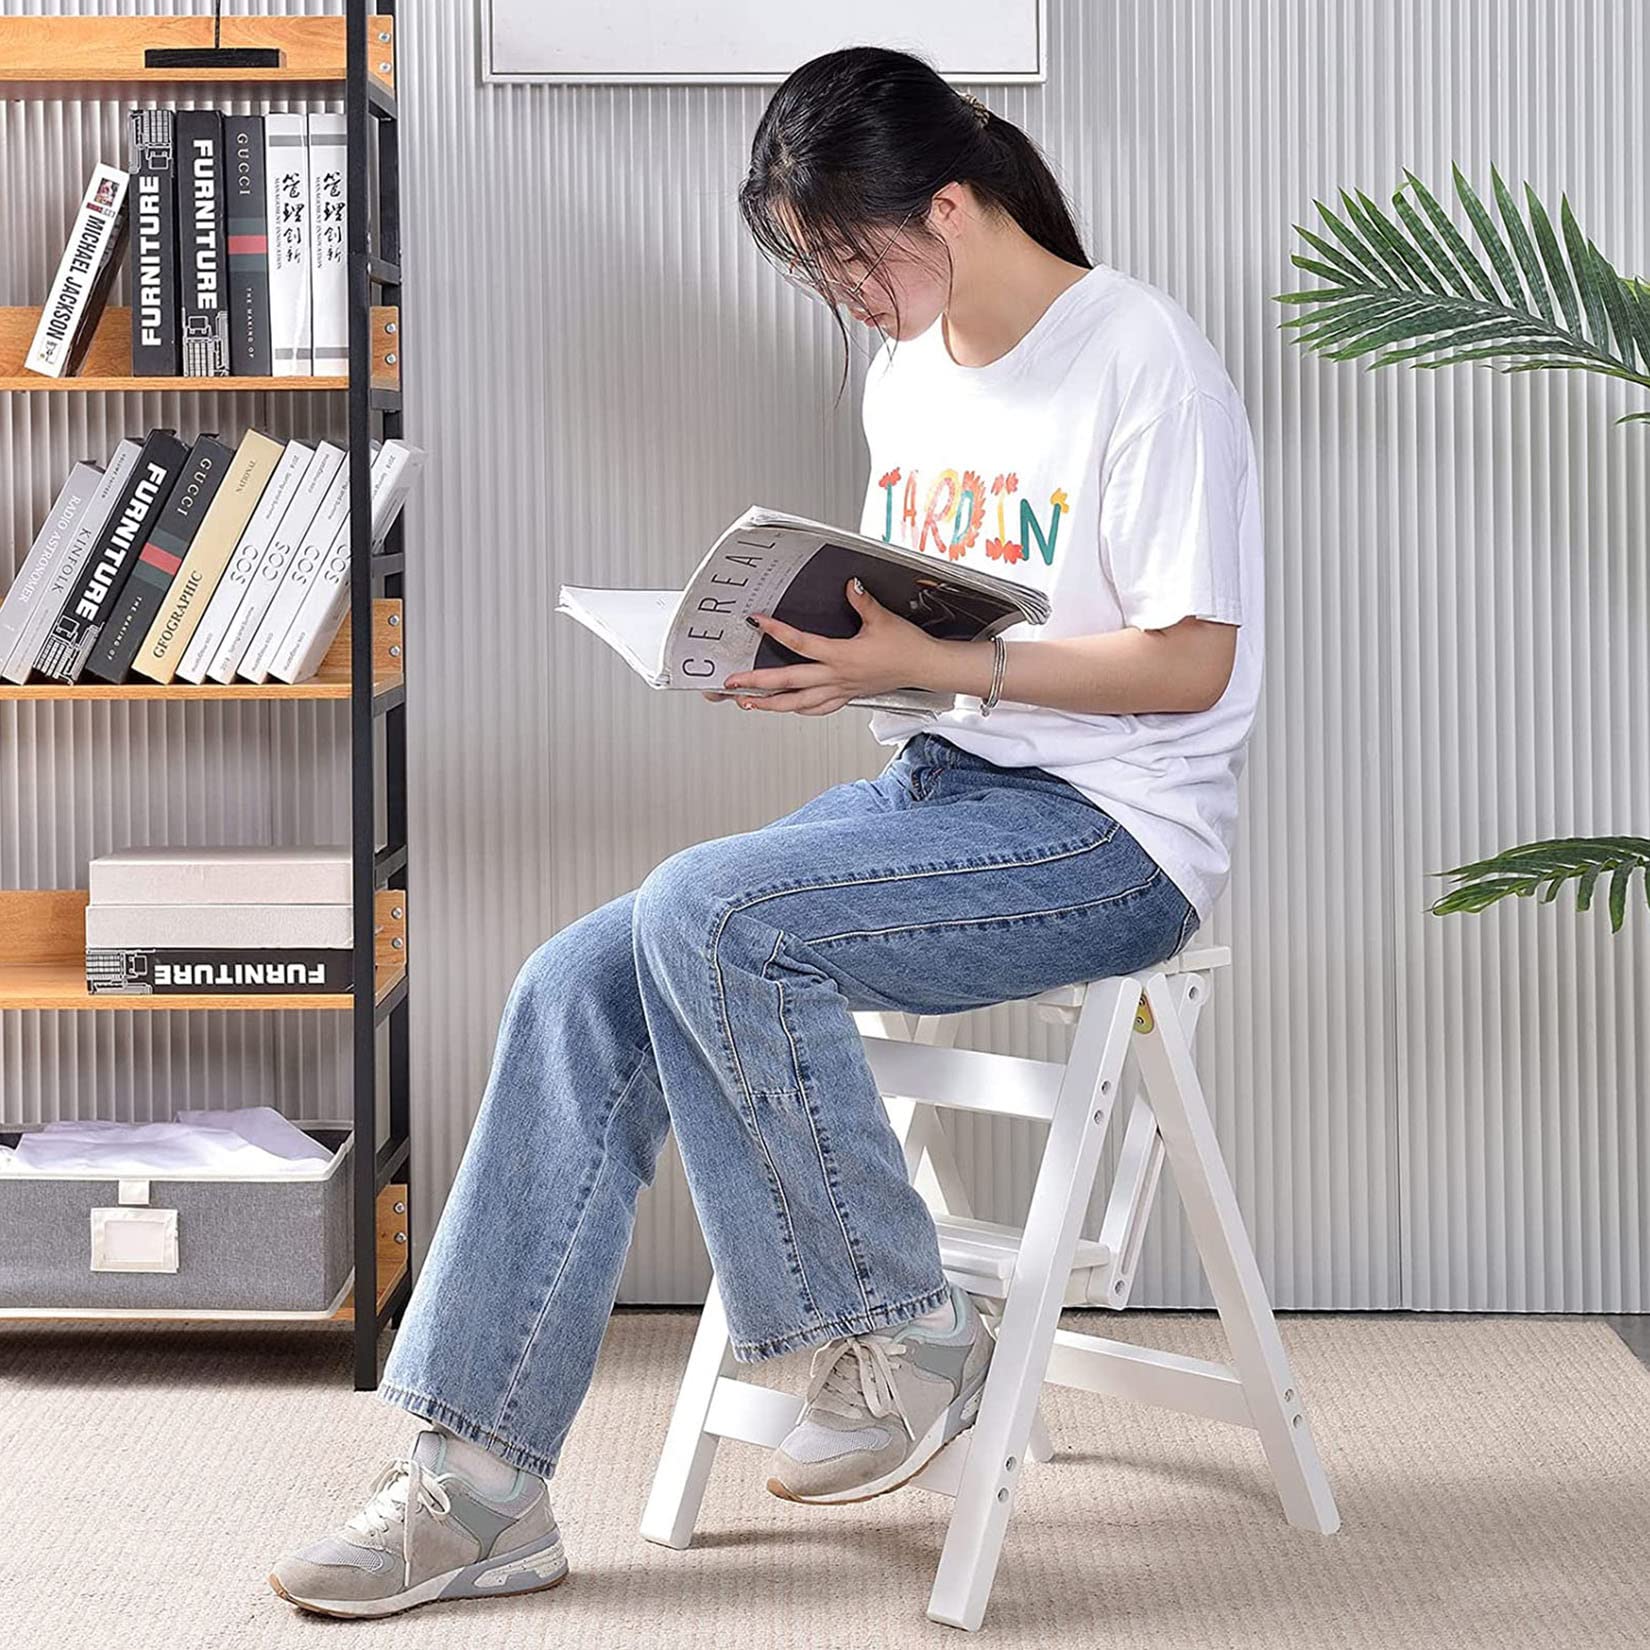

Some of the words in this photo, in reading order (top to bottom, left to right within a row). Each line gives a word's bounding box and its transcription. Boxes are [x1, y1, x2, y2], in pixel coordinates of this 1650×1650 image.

[237, 133, 250, 194] GUCCI
[70, 216, 106, 274] MICHAEL
[193, 139, 218, 310] FURNITURE
[140, 177, 161, 345] FURNITURE
[47, 277, 82, 341] JACKSON
[58, 496, 81, 530] RADIO
[178, 458, 212, 516] GUCCI
[879, 467, 1069, 565] JARDIN
[19, 531, 61, 603] ASTRONOMER
[52, 528, 92, 594] KINFOLK
[76, 464, 167, 621] FURNITURE
[230, 546, 259, 585] COS
[262, 542, 291, 581] COS
[292, 546, 320, 585] COS
[325, 545, 351, 584] COS
[114, 616, 132, 646] MAKING
[132, 597, 142, 612] THE
[682, 541, 776, 677] CEREAL
[155, 965, 324, 984] FURNITURE
